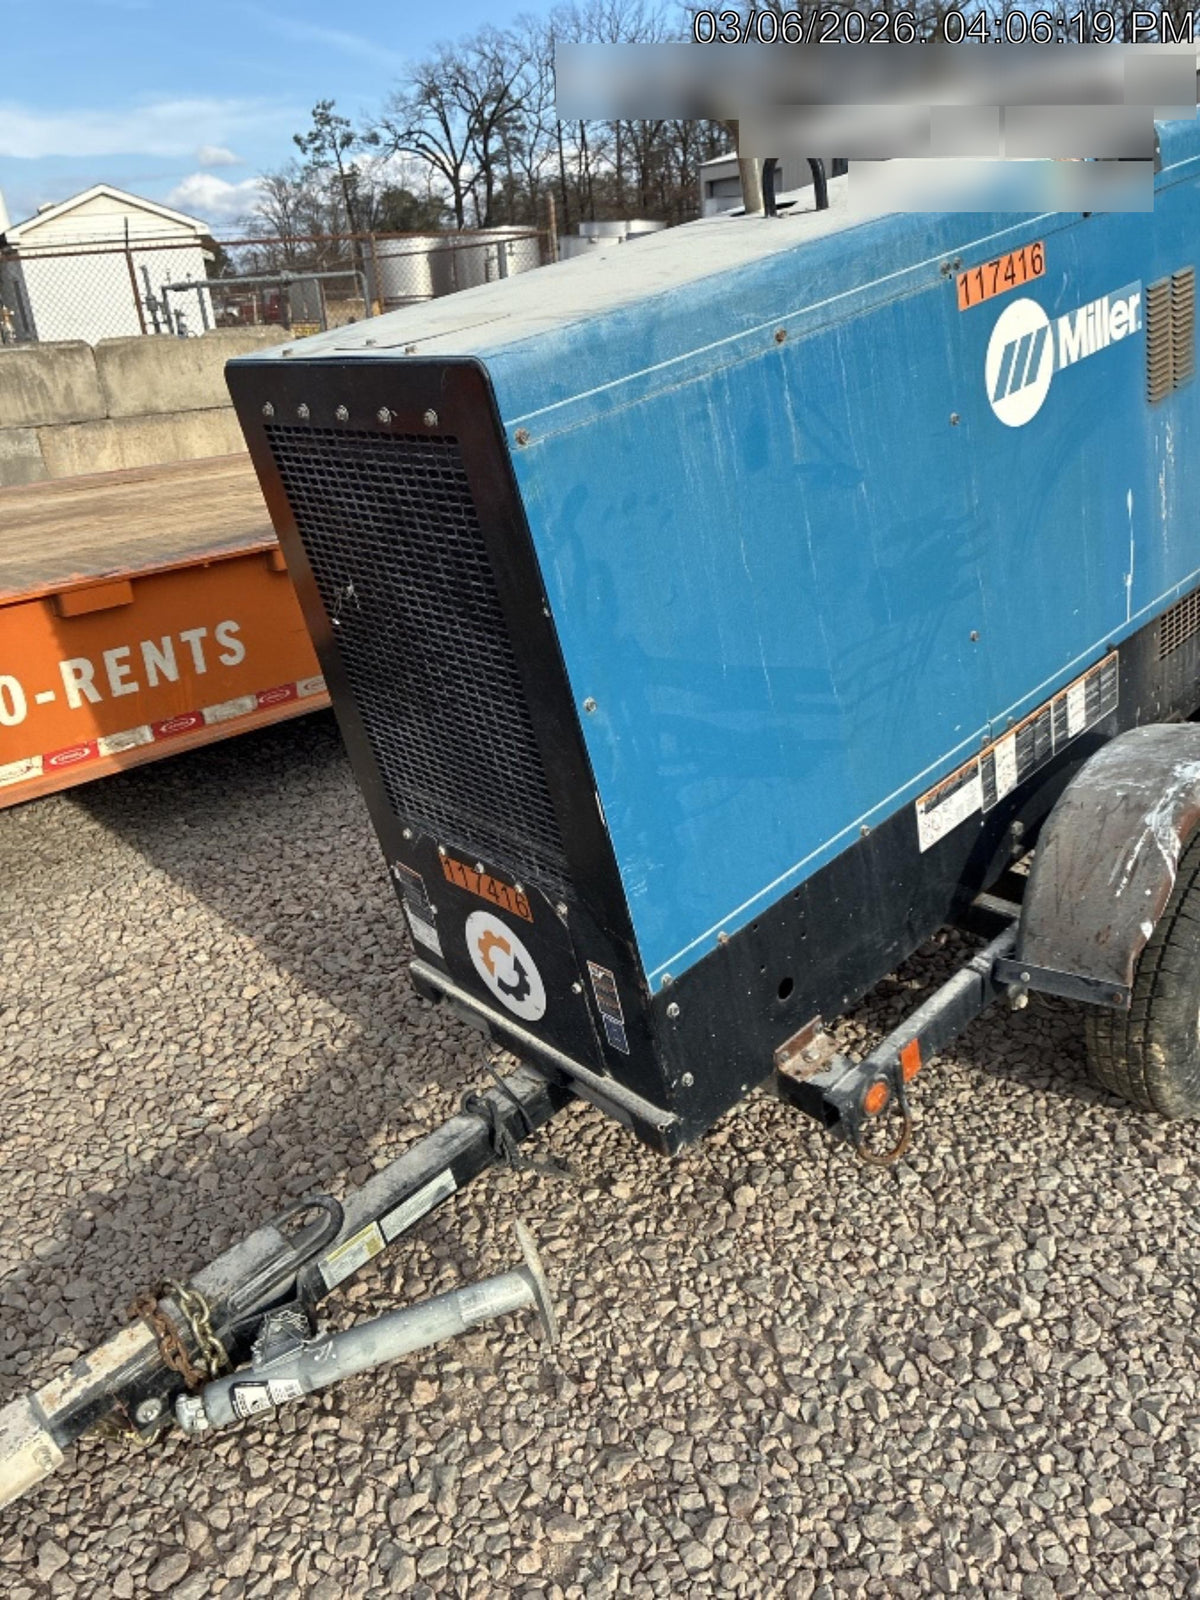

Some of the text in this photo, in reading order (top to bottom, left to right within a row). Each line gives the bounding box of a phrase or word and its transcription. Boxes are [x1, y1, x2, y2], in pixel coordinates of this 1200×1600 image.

[959, 242, 1044, 307] 117416
[1057, 292, 1142, 370] Miller
[443, 857, 530, 918] 117416
